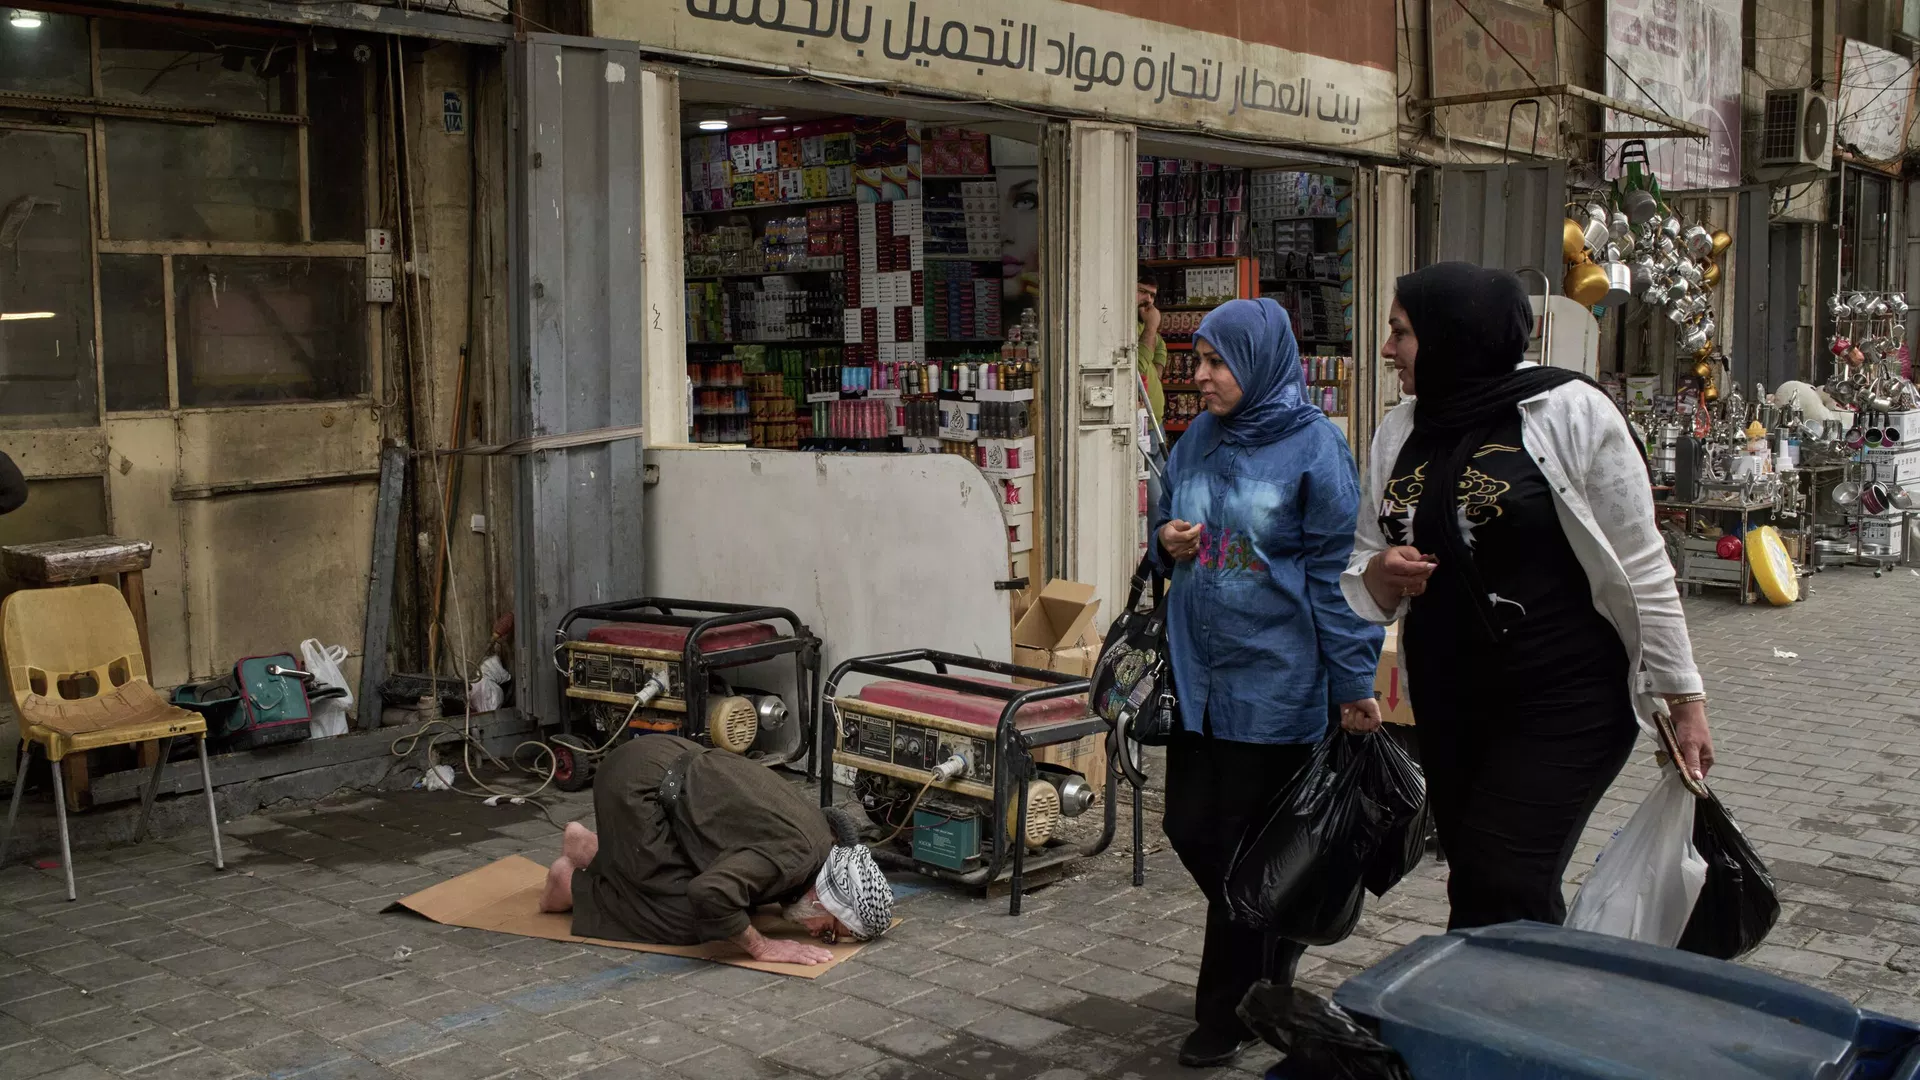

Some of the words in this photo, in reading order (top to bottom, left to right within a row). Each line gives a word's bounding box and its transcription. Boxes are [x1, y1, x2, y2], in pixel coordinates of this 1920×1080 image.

[882, 1, 1038, 76] التجميل
[1044, 32, 1125, 93] مواد
[1133, 45, 1223, 110] لتجارة
[1228, 66, 1311, 118] العطار
[1317, 82, 1360, 136] بيت
